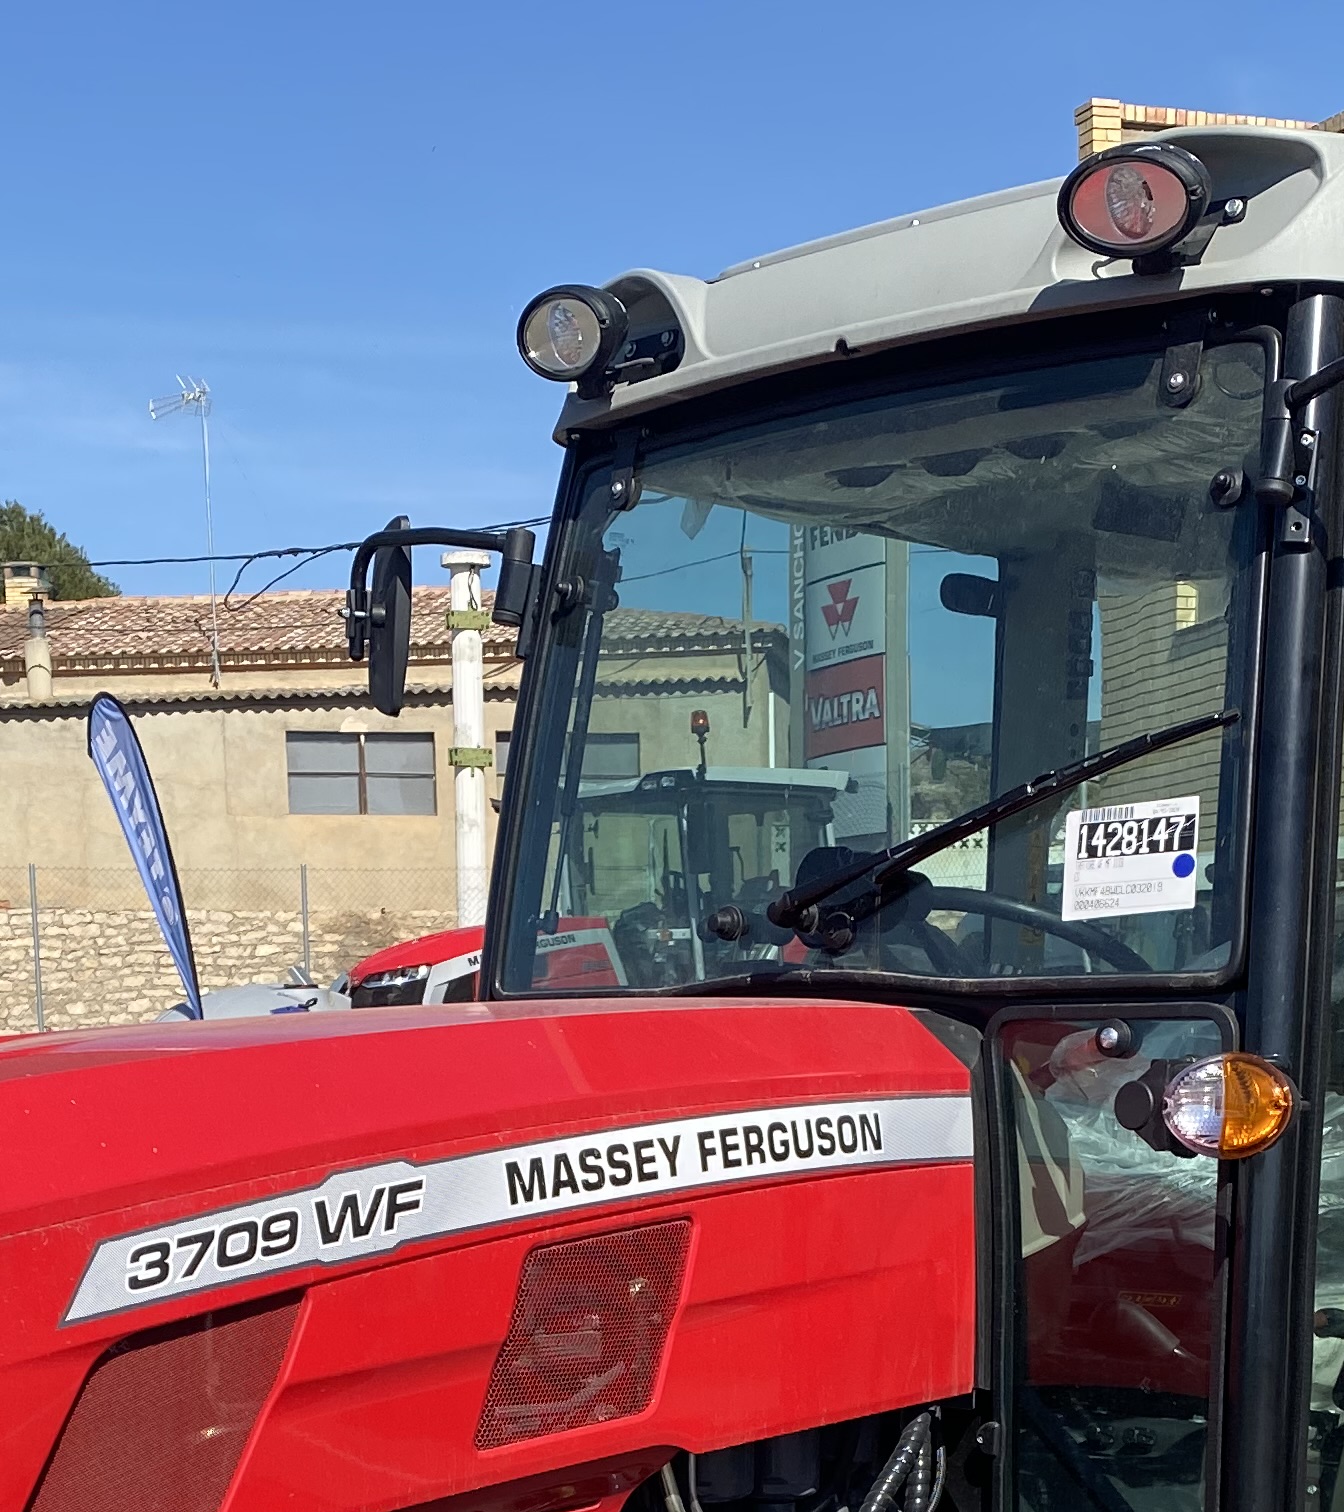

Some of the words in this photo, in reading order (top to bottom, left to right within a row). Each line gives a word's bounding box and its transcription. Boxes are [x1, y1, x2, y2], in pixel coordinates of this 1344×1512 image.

[838, 639, 874, 657] FERGUSON
[809, 687, 881, 731] VALTRA
[1077, 815, 1186, 859] 1428147
[536, 933, 576, 949] GUSON
[504, 1132, 683, 1207] MASSEY
[696, 1110, 885, 1172] FERGUSON
[125, 1208, 299, 1292] 3709
[312, 1176, 426, 1247] WF
